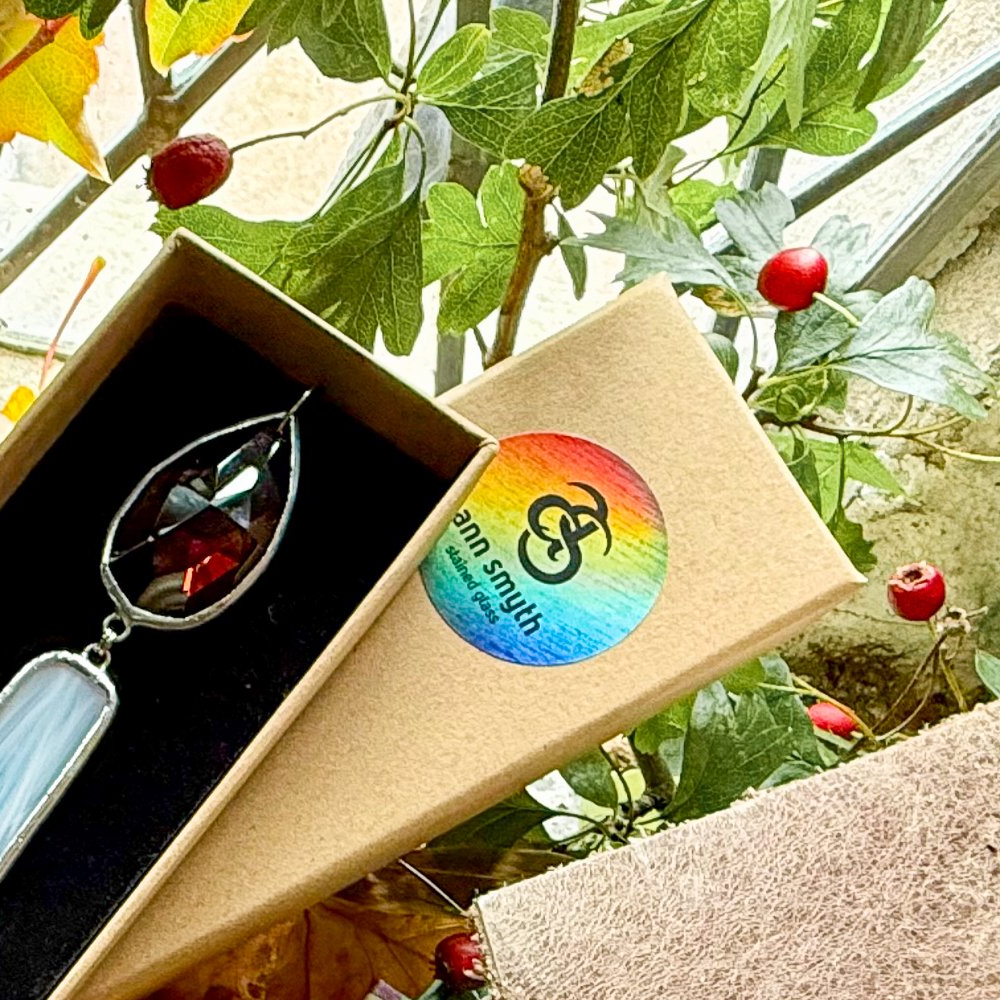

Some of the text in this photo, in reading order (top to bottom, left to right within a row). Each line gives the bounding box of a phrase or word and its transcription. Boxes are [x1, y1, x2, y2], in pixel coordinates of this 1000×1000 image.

[445, 545, 499, 625] stained glass
[453, 508, 543, 636] ann smyth
